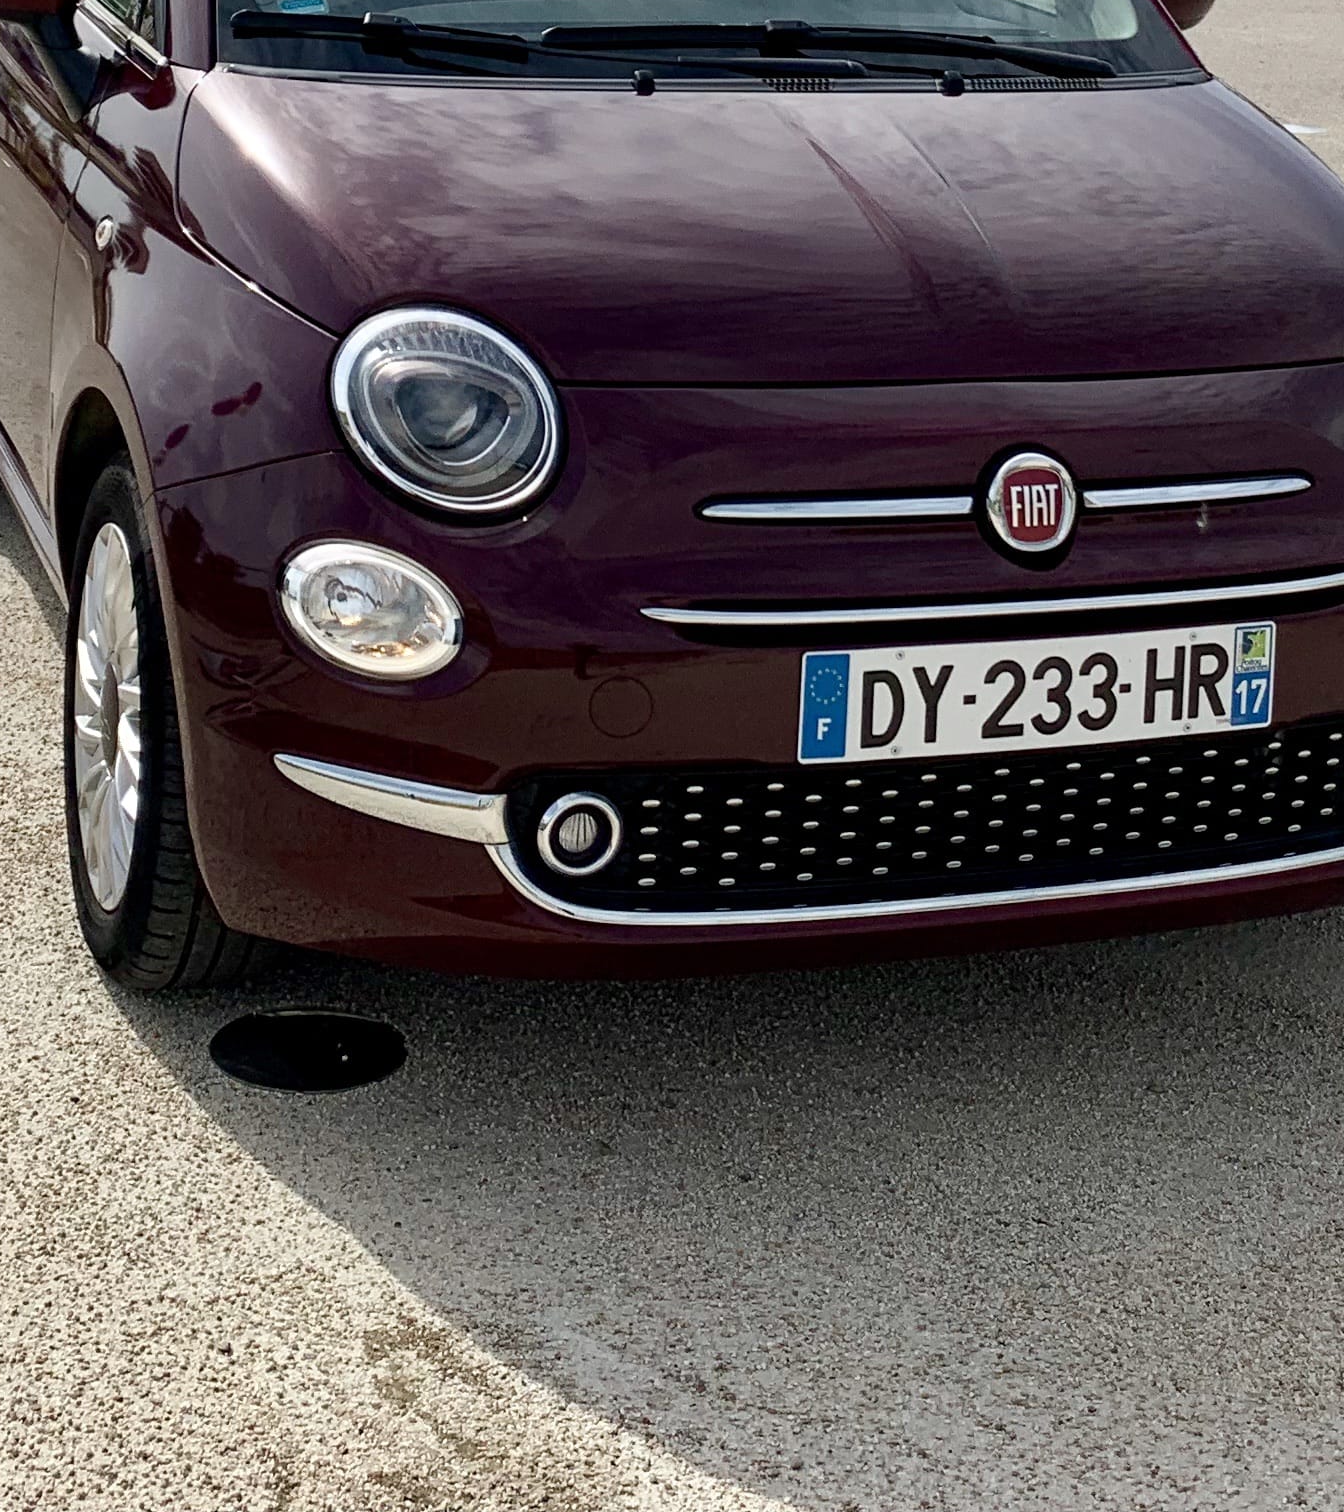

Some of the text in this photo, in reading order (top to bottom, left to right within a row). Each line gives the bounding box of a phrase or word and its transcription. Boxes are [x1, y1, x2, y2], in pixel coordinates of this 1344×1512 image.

[1010, 483, 1058, 527] FIAT
[860, 642, 1229, 749] DY-233-HR
[1236, 678, 1267, 715] 17
[817, 718, 832, 740] F
